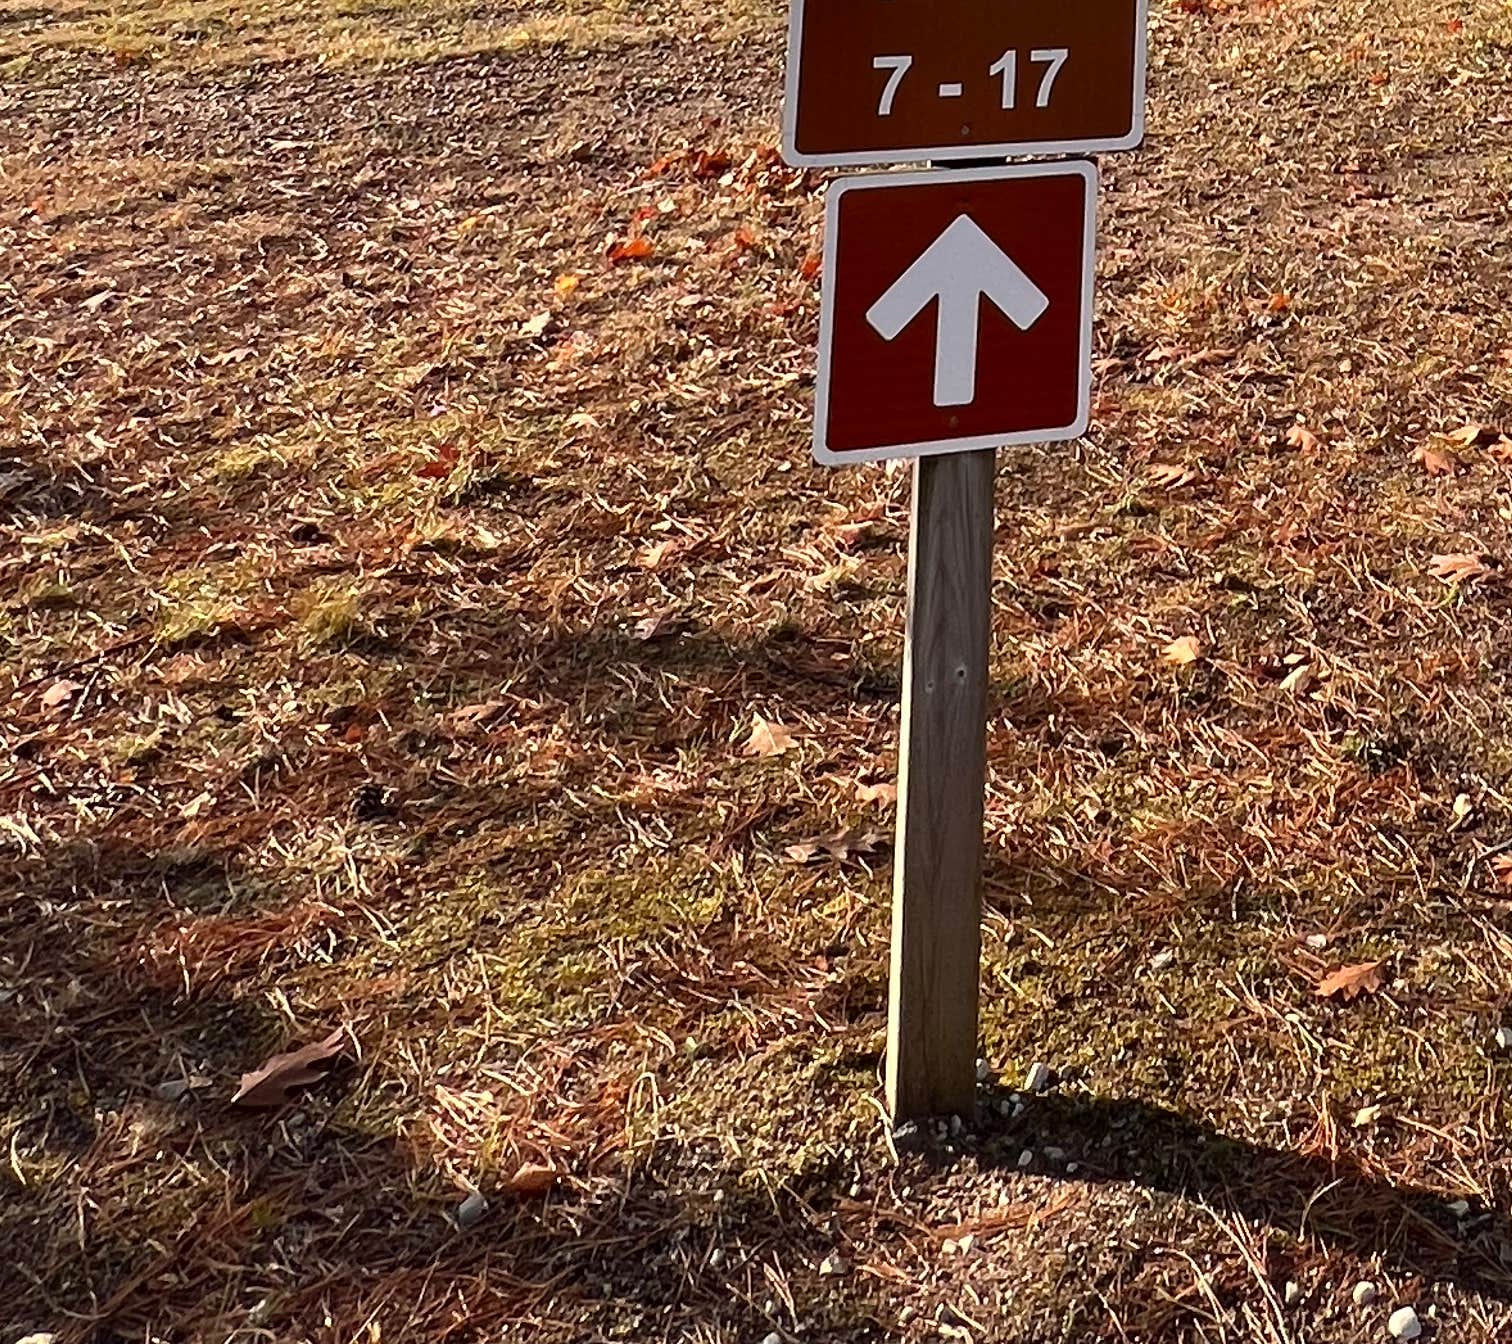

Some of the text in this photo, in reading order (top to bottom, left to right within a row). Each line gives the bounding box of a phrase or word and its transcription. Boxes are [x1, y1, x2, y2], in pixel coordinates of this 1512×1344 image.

[873, 49, 1068, 115] 7 - 17
